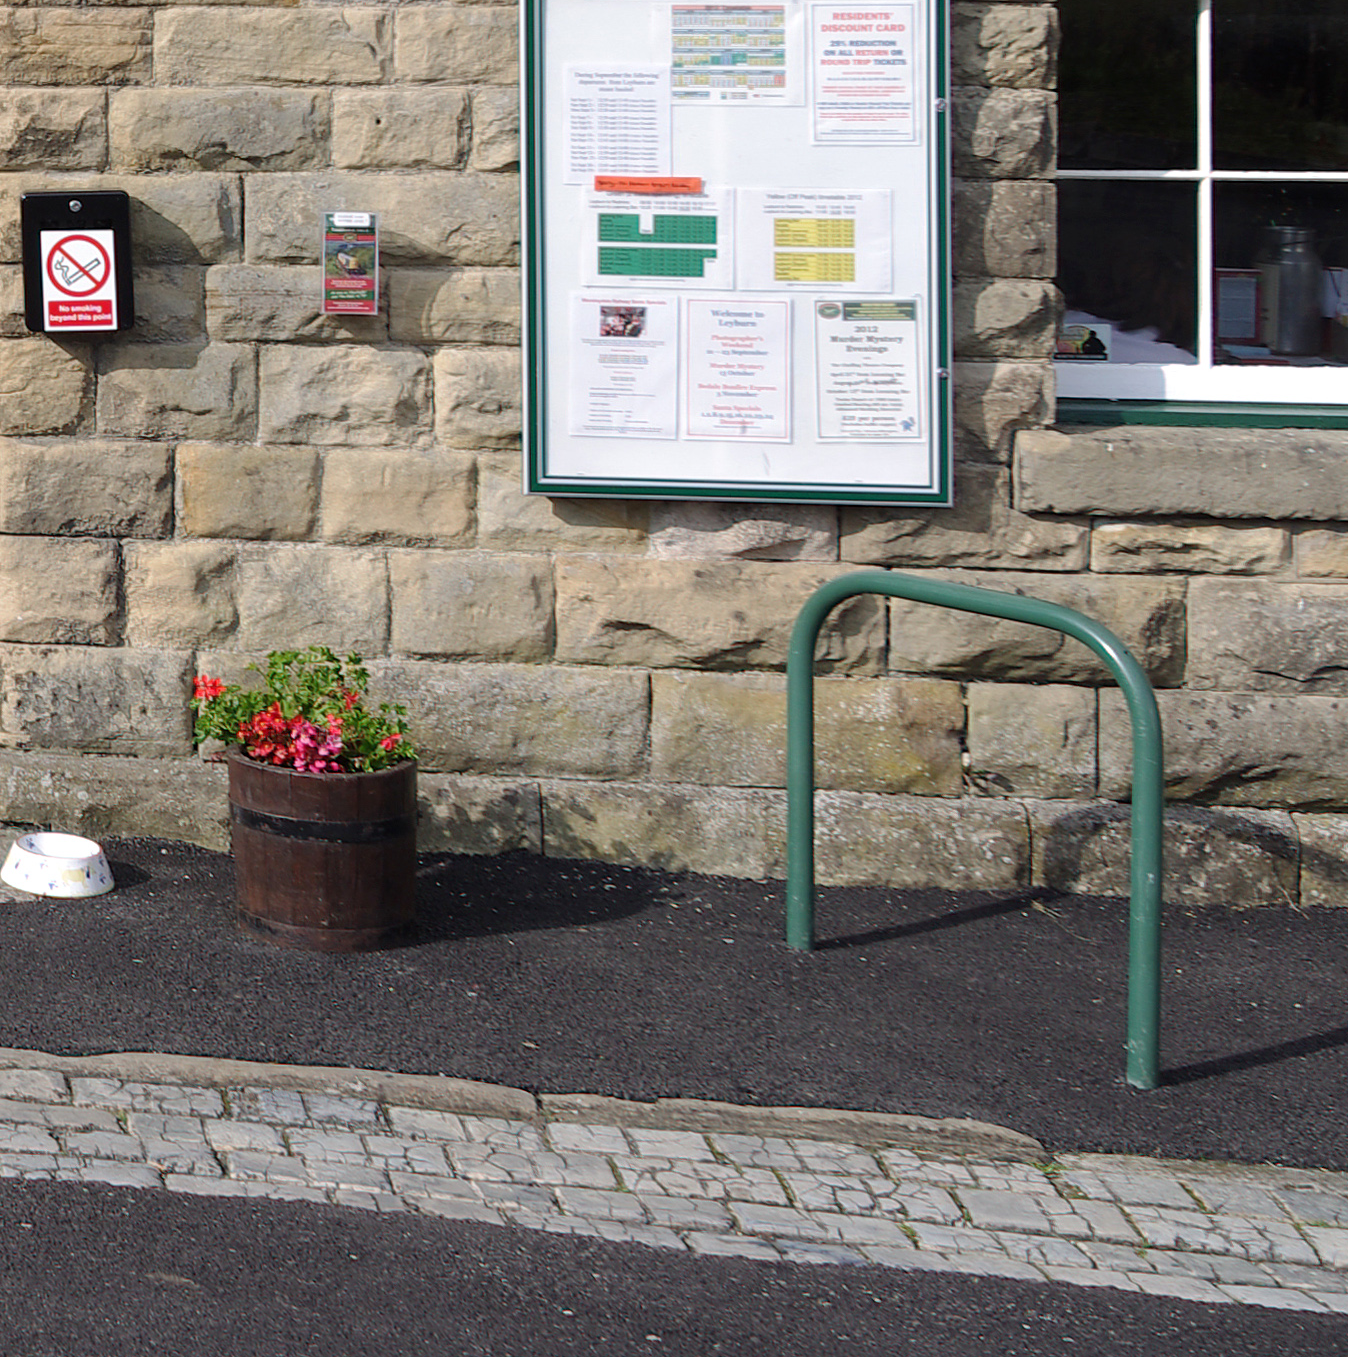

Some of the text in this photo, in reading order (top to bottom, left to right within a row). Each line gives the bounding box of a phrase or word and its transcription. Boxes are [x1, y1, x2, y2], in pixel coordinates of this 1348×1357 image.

[832, 12, 894, 20] RESIDENTS'
[821, 24, 906, 32] DISCOUNT CARD
[71, 305, 102, 313] smoking
[50, 314, 76, 322] beyond
